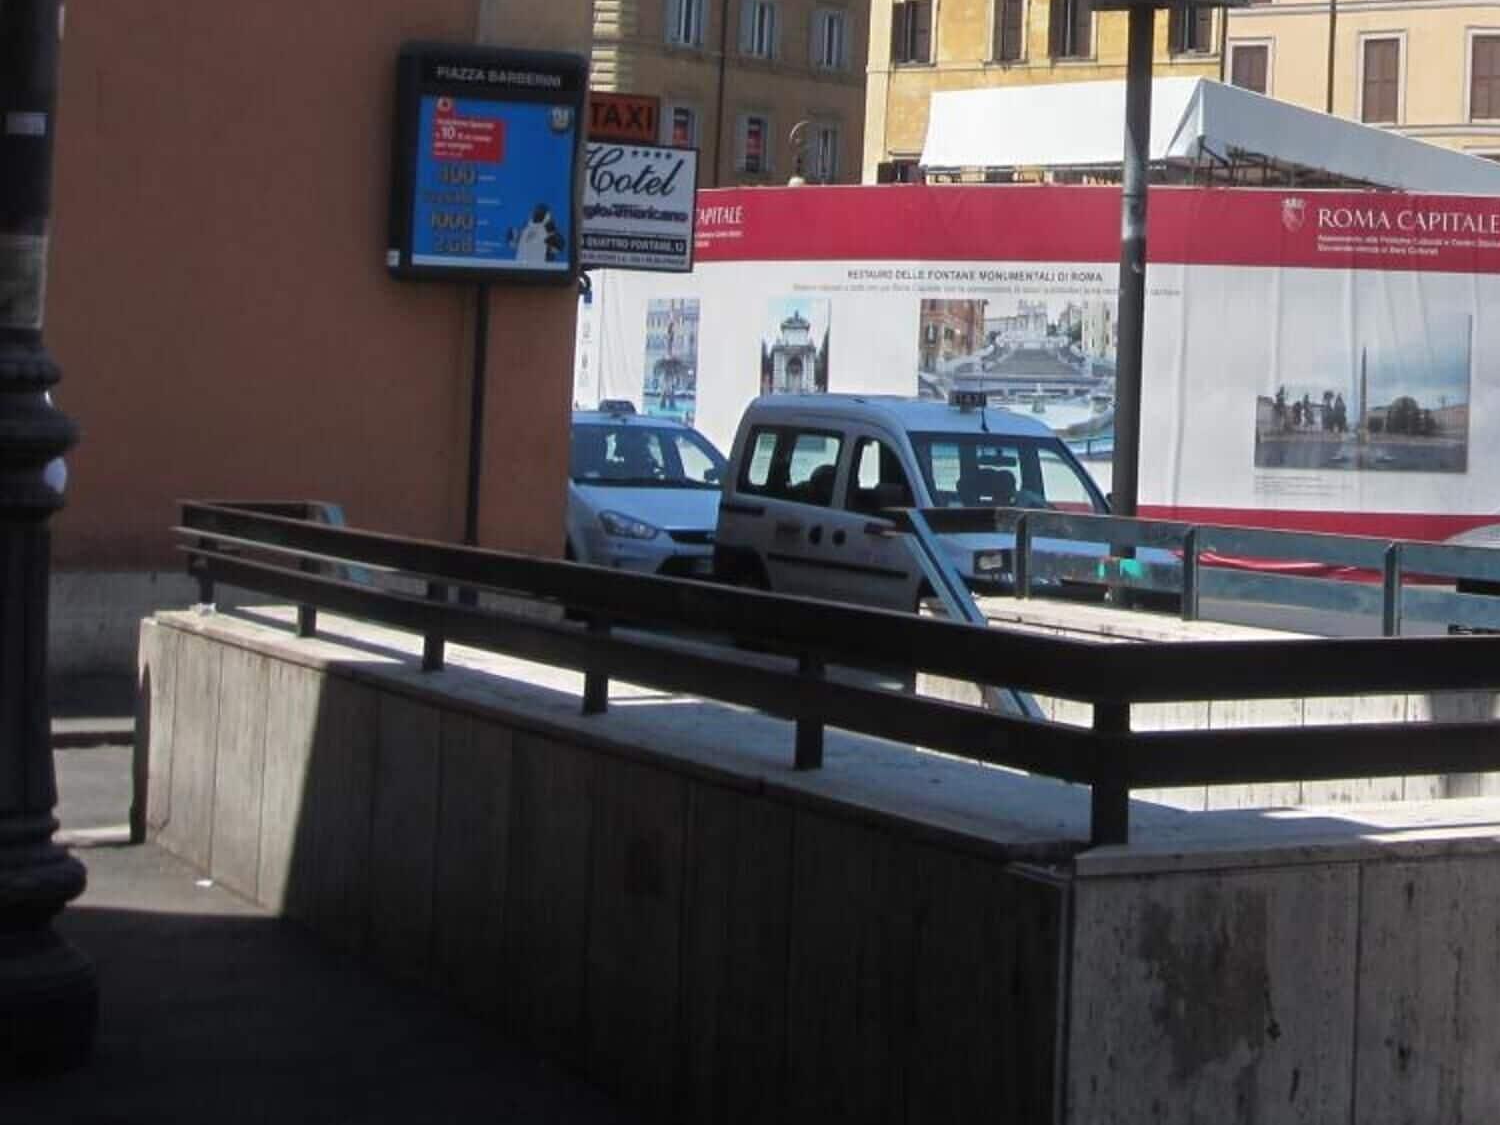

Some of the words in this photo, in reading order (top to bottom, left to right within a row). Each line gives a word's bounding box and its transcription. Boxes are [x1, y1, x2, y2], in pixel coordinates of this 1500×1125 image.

[436, 66, 485, 81] PIAZZA
[487, 70, 561, 88] BARBERINI
[590, 101, 654, 132] TAXI
[440, 125, 456, 140] 10
[697, 205, 743, 225] APITALE
[1318, 208, 1391, 230] ROMA
[895, 269, 926, 280] DELLE
[927, 269, 975, 281] FONTANE
[979, 270, 1055, 283] MONUMENTALI
[1057, 271, 1069, 283] DI
[1071, 271, 1104, 283] ROMA
